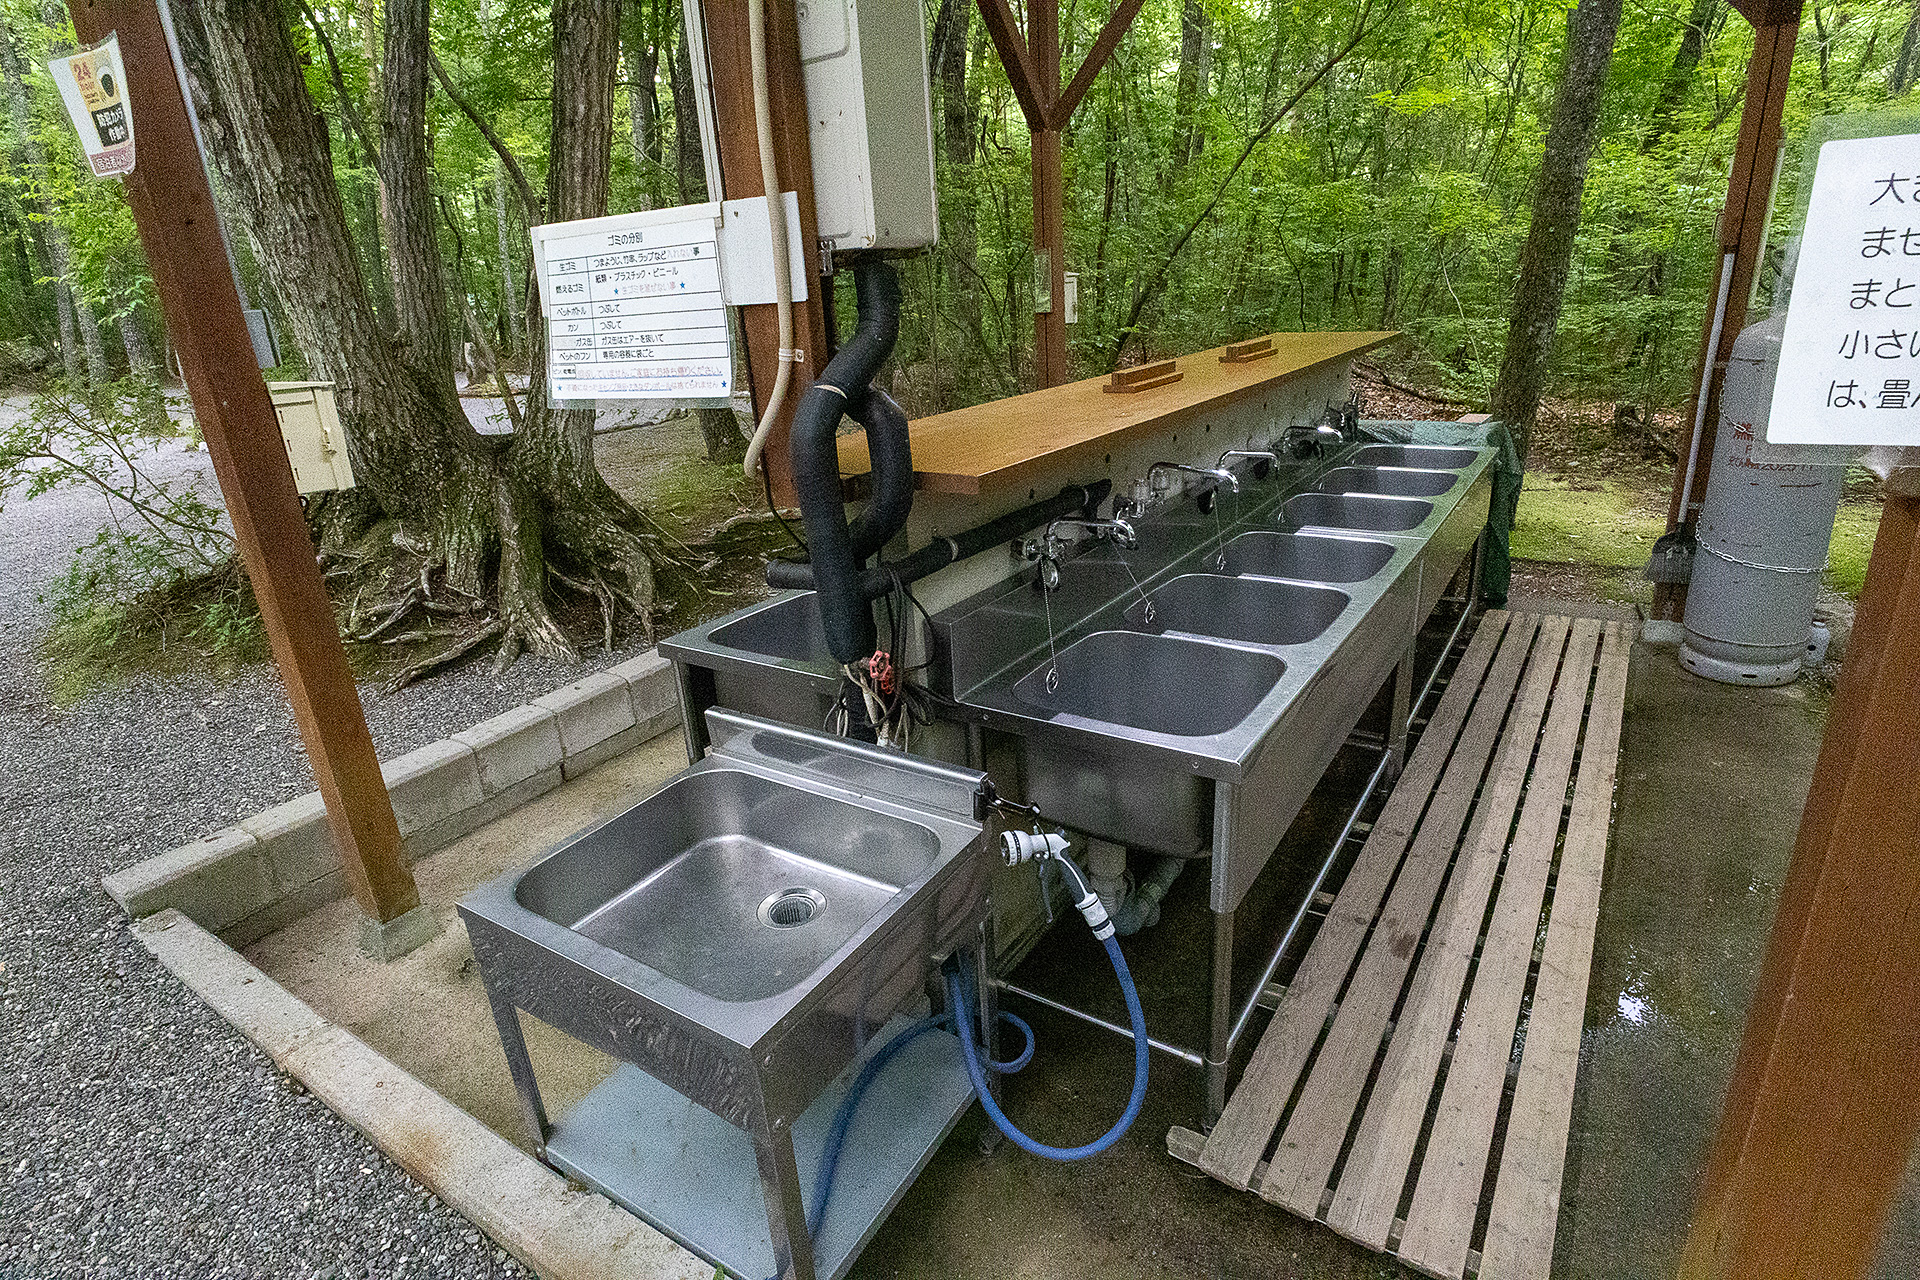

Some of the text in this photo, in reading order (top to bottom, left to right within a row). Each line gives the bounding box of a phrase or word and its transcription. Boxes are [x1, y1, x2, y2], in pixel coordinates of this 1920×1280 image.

[74, 62, 92, 81] 24
[96, 107, 124, 127] 防犯カメラ
[608, 232, 643, 246] ゴミの分別
[559, 261, 576, 271] 生ゴミ
[555, 283, 584, 293] 燃えるゴミ
[557, 306, 587, 316] ペットボトル
[599, 304, 620, 314] つぶして
[568, 324, 579, 332] カン
[600, 321, 622, 330] つぶして
[559, 352, 591, 361] ペットのフン
[1827, 379, 1920, 409] は、畳
